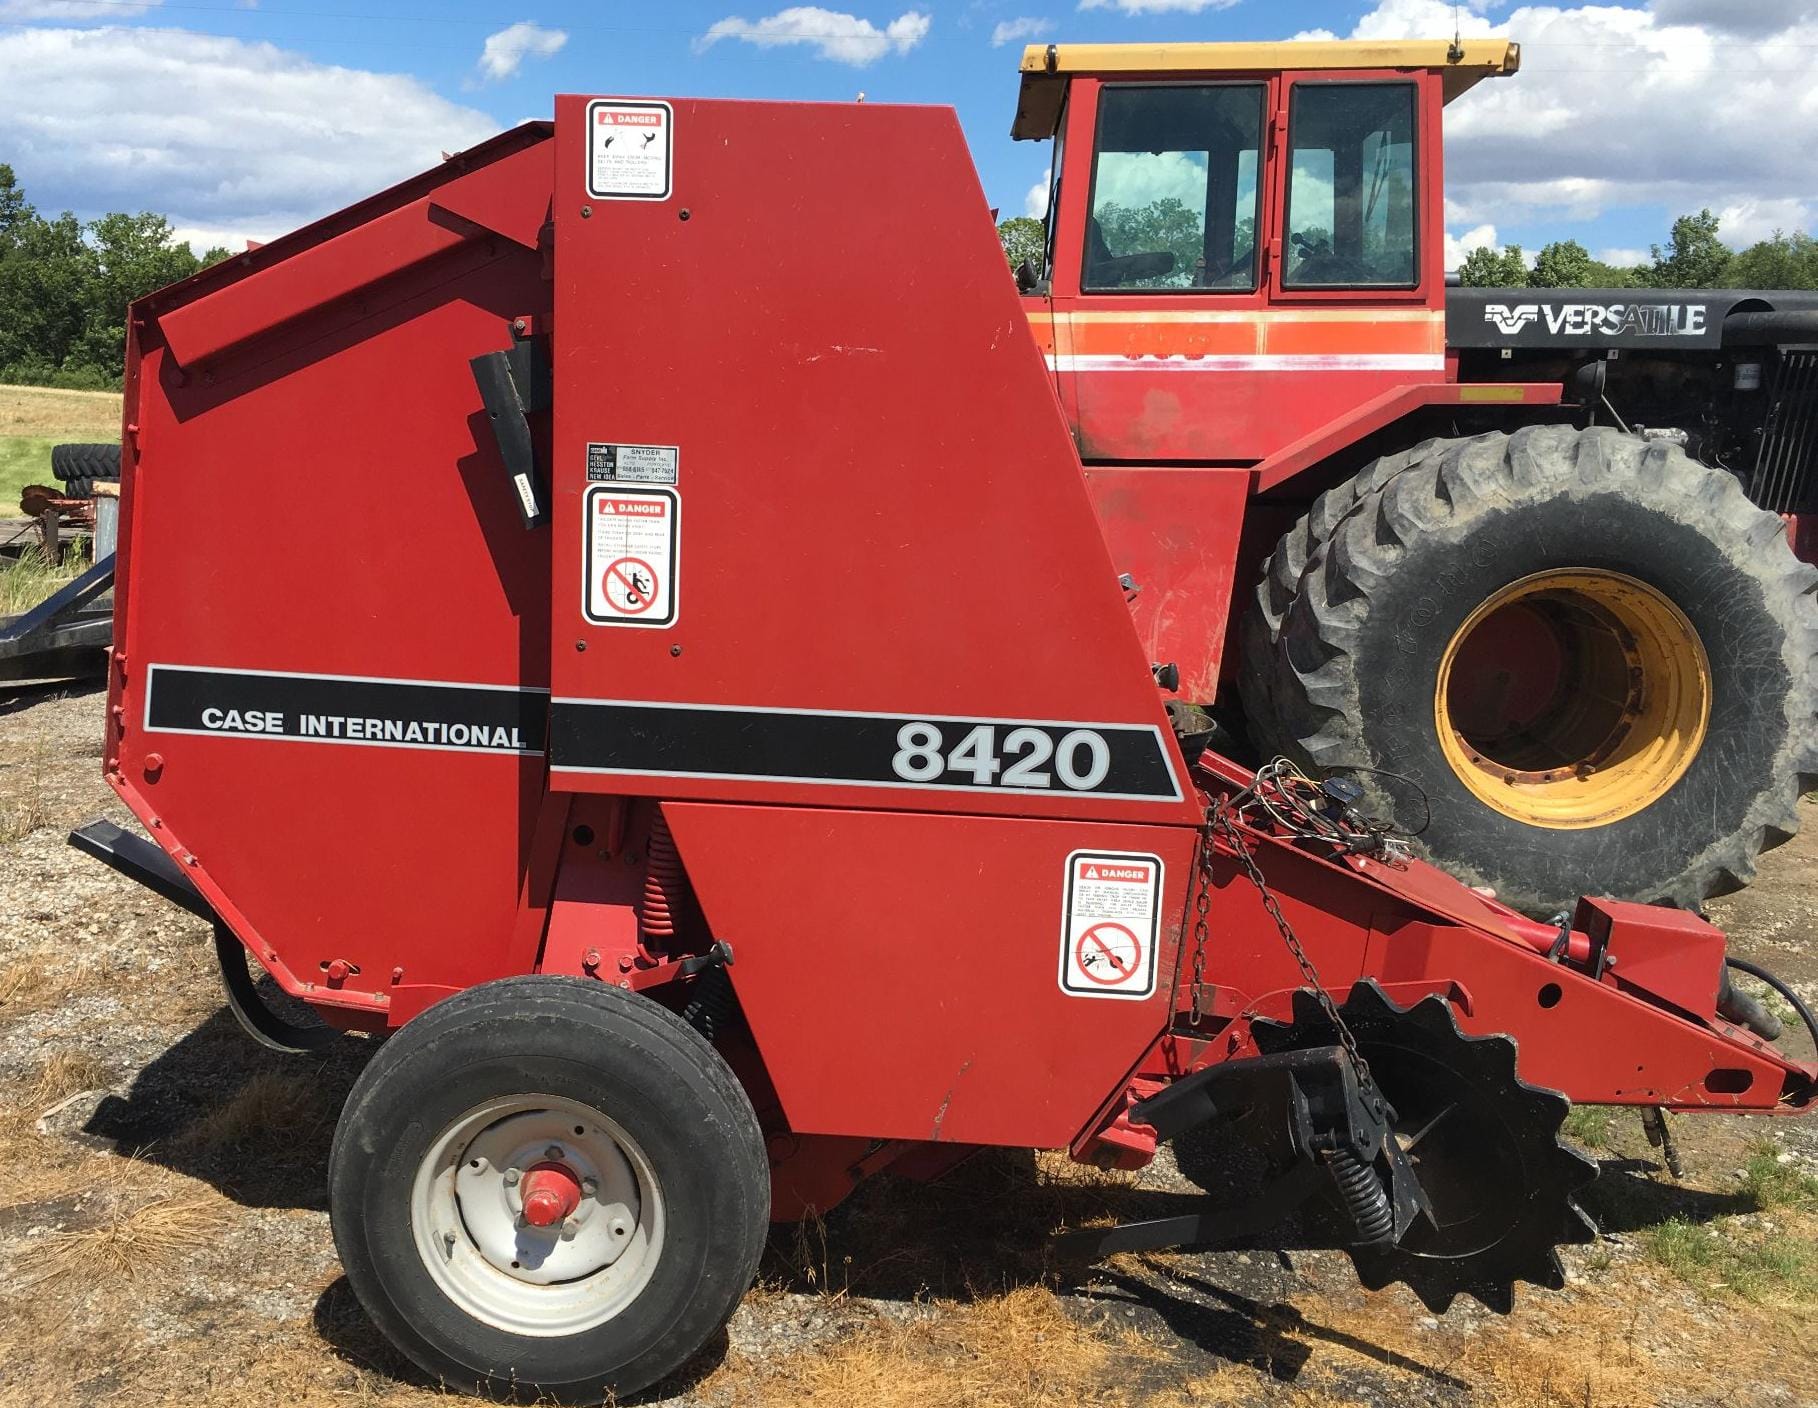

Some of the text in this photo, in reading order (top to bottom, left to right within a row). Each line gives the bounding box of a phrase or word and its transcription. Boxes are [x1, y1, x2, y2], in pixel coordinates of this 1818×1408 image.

[617, 115, 657, 124] DANGER
[1541, 304, 1707, 336] VERSATILE
[618, 504, 662, 514] DANGER
[201, 707, 528, 749] CASE INTERNATIONAL
[892, 721, 1111, 791] 8420
[1101, 869, 1145, 879] DANGER
